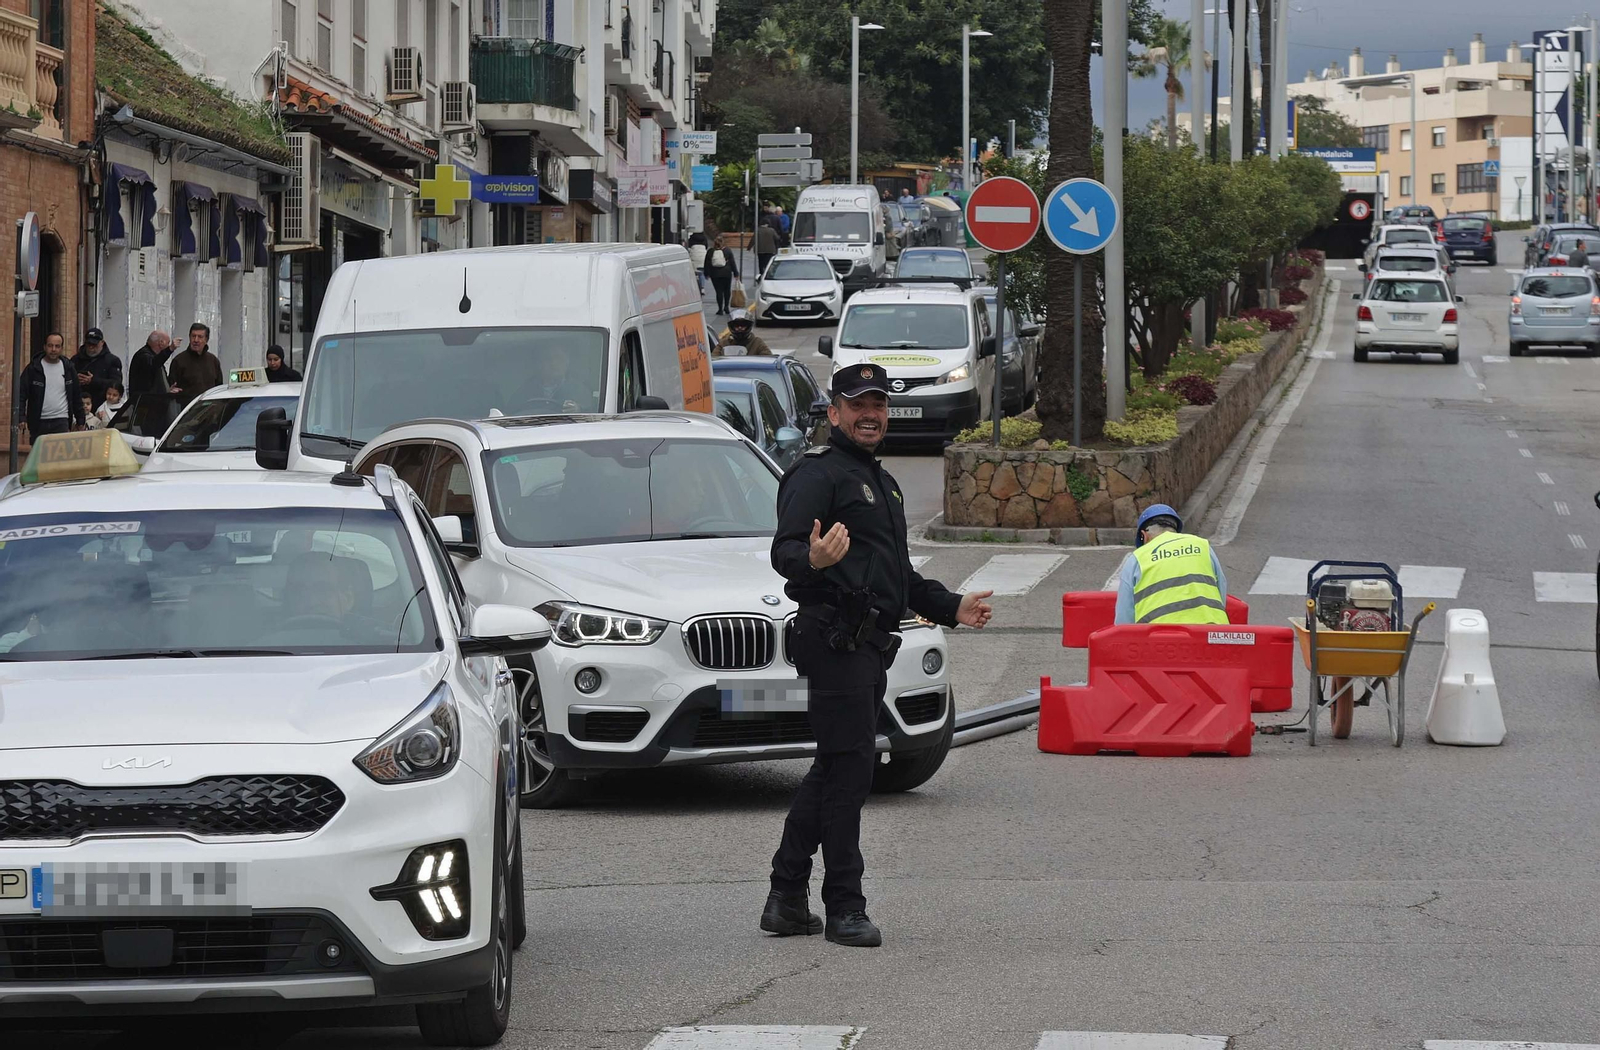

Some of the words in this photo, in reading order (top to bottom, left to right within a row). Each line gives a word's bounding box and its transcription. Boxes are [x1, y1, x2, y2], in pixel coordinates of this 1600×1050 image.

[683, 140, 700, 149] 0%
[237, 371, 255, 381] TAXI
[904, 408, 920, 417] KXP
[44, 438, 90, 460] TAXI
[0, 526, 68, 540] ADIO
[78, 523, 134, 533] TAXI
[1151, 544, 1201, 561] albaida
[102, 755, 172, 770] KIA
